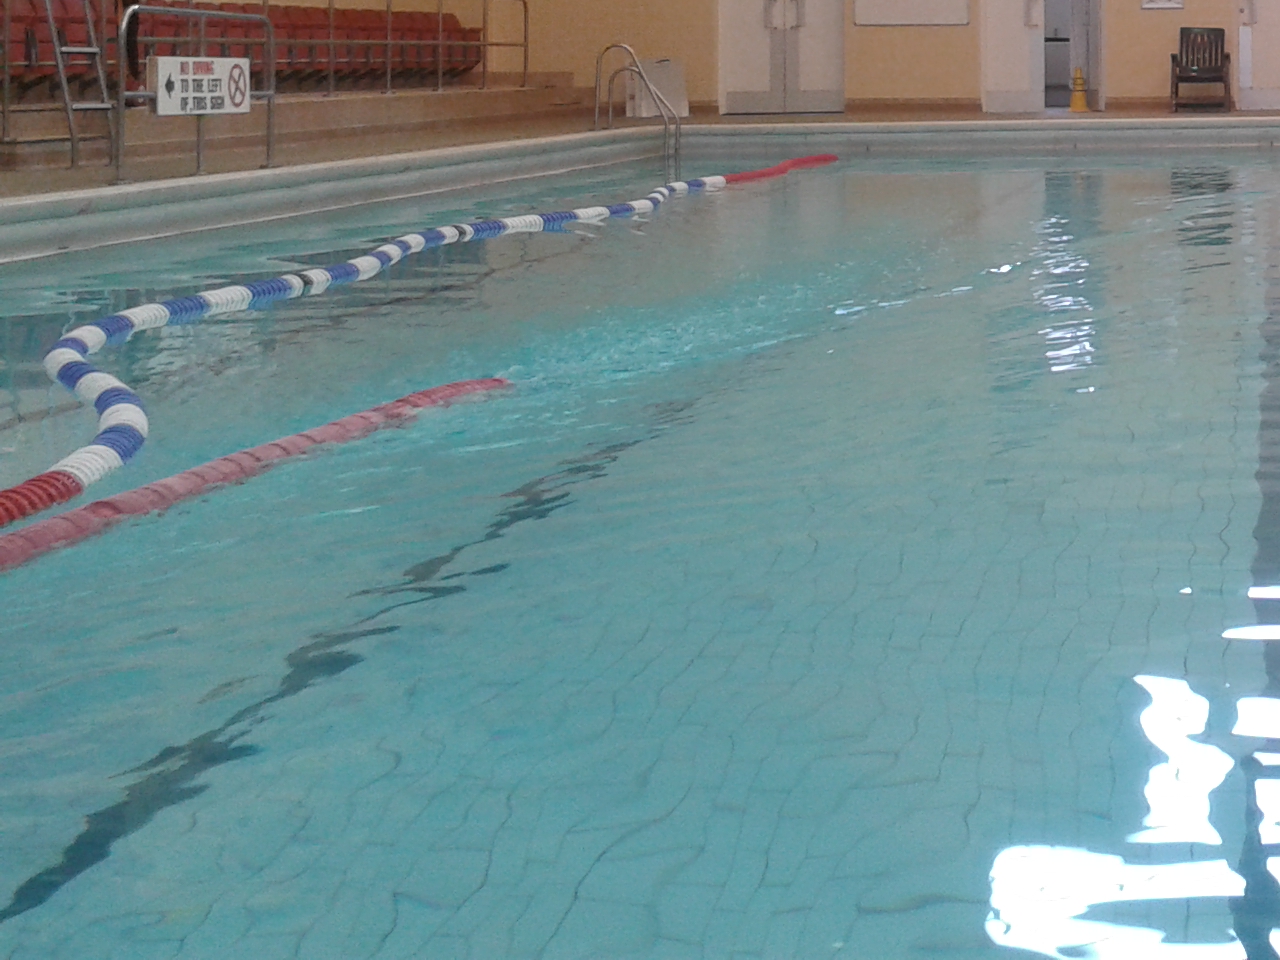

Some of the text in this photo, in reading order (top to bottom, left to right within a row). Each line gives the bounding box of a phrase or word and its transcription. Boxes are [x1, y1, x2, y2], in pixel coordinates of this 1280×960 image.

[180, 61, 189, 75] NO
[180, 78, 222, 93] TO THE LEFT
[180, 96, 225, 111] OF THIS SIGN
